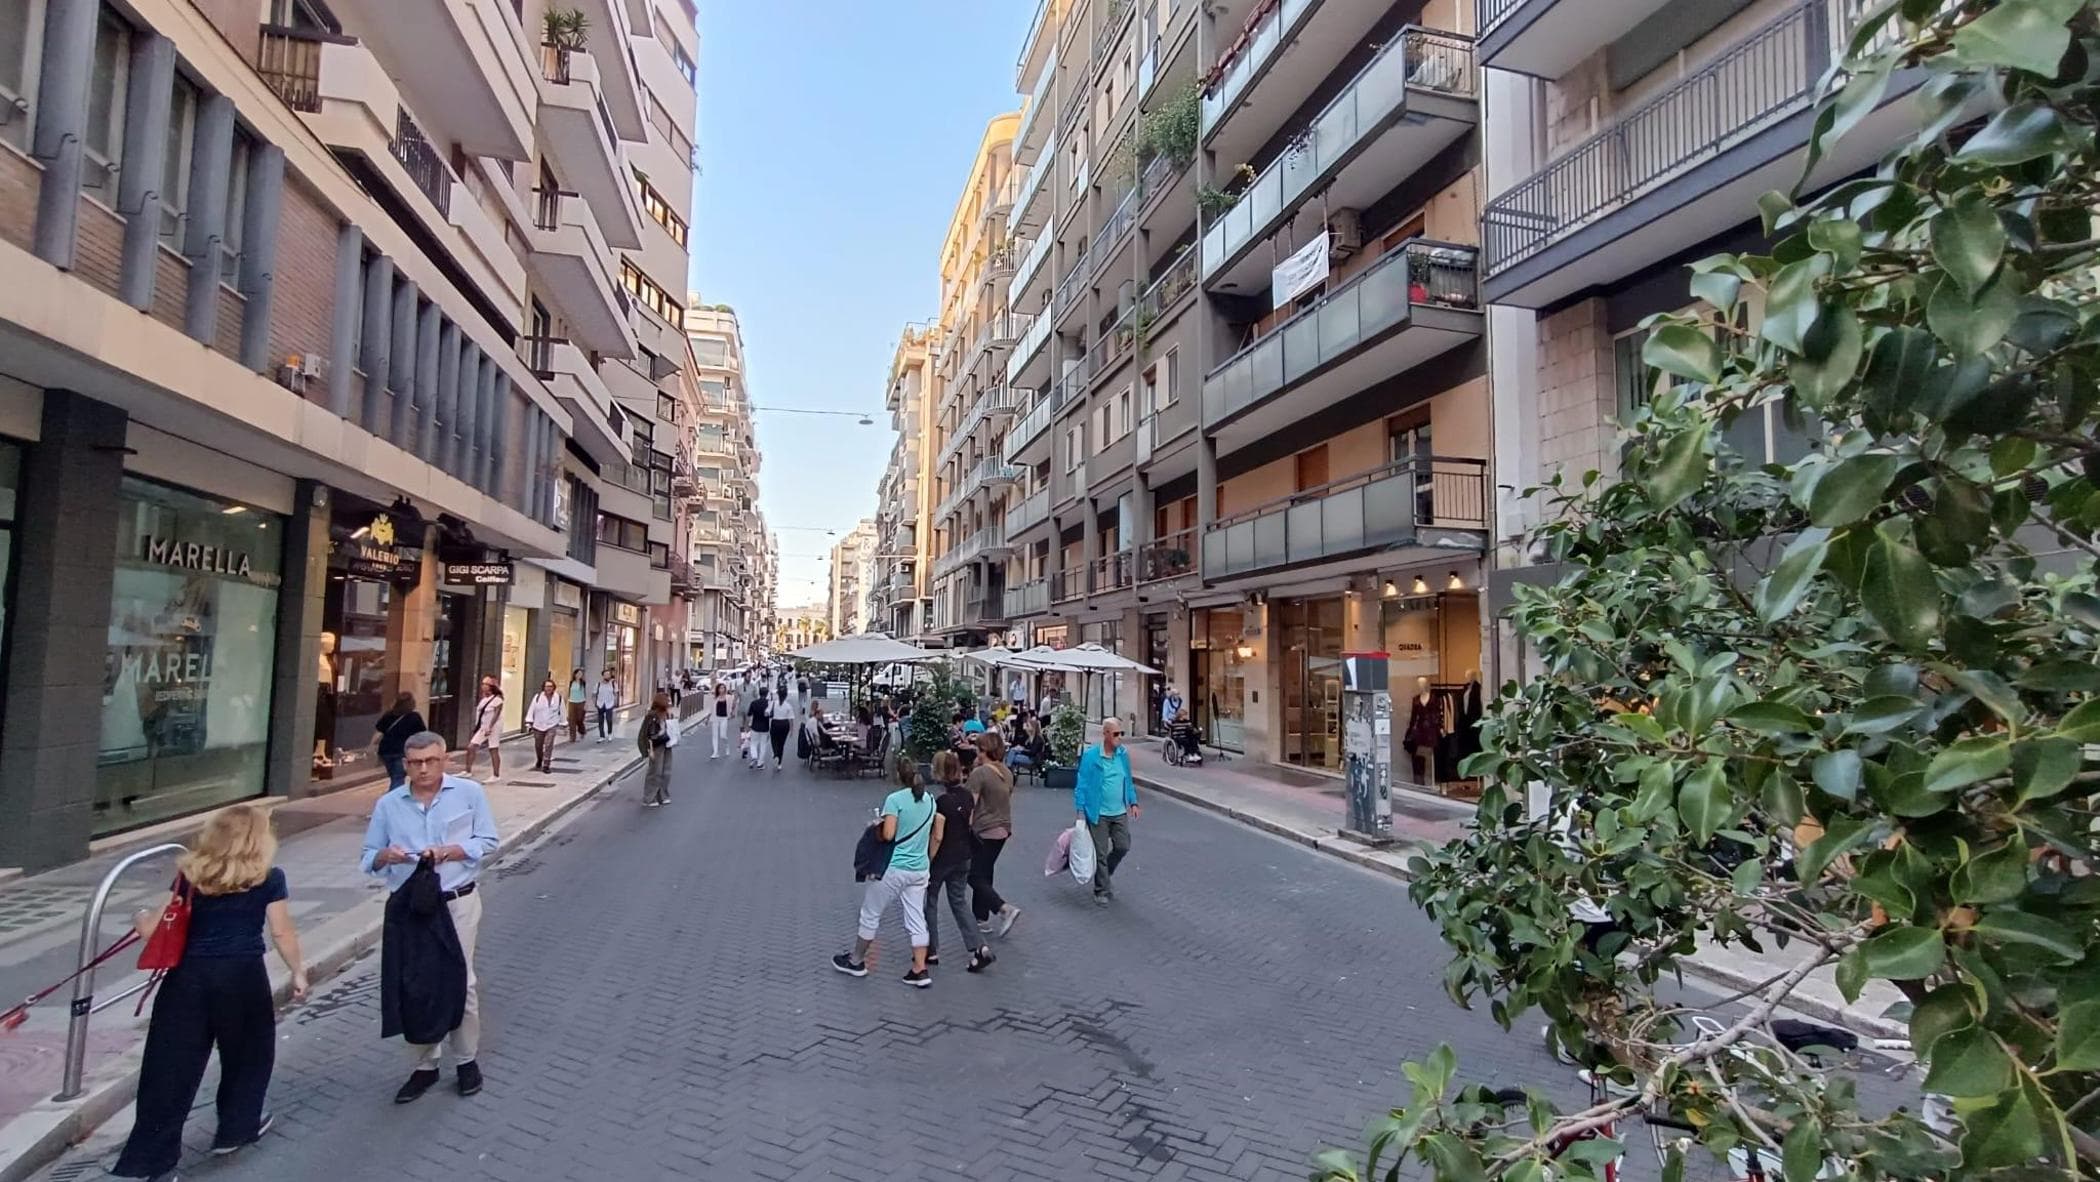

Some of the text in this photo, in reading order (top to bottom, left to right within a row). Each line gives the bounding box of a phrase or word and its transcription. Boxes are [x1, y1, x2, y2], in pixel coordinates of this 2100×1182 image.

[149, 537, 251, 577] MARELLA
[361, 545, 399, 566] VALERIO
[448, 565, 509, 575] GIGI SCARPA
